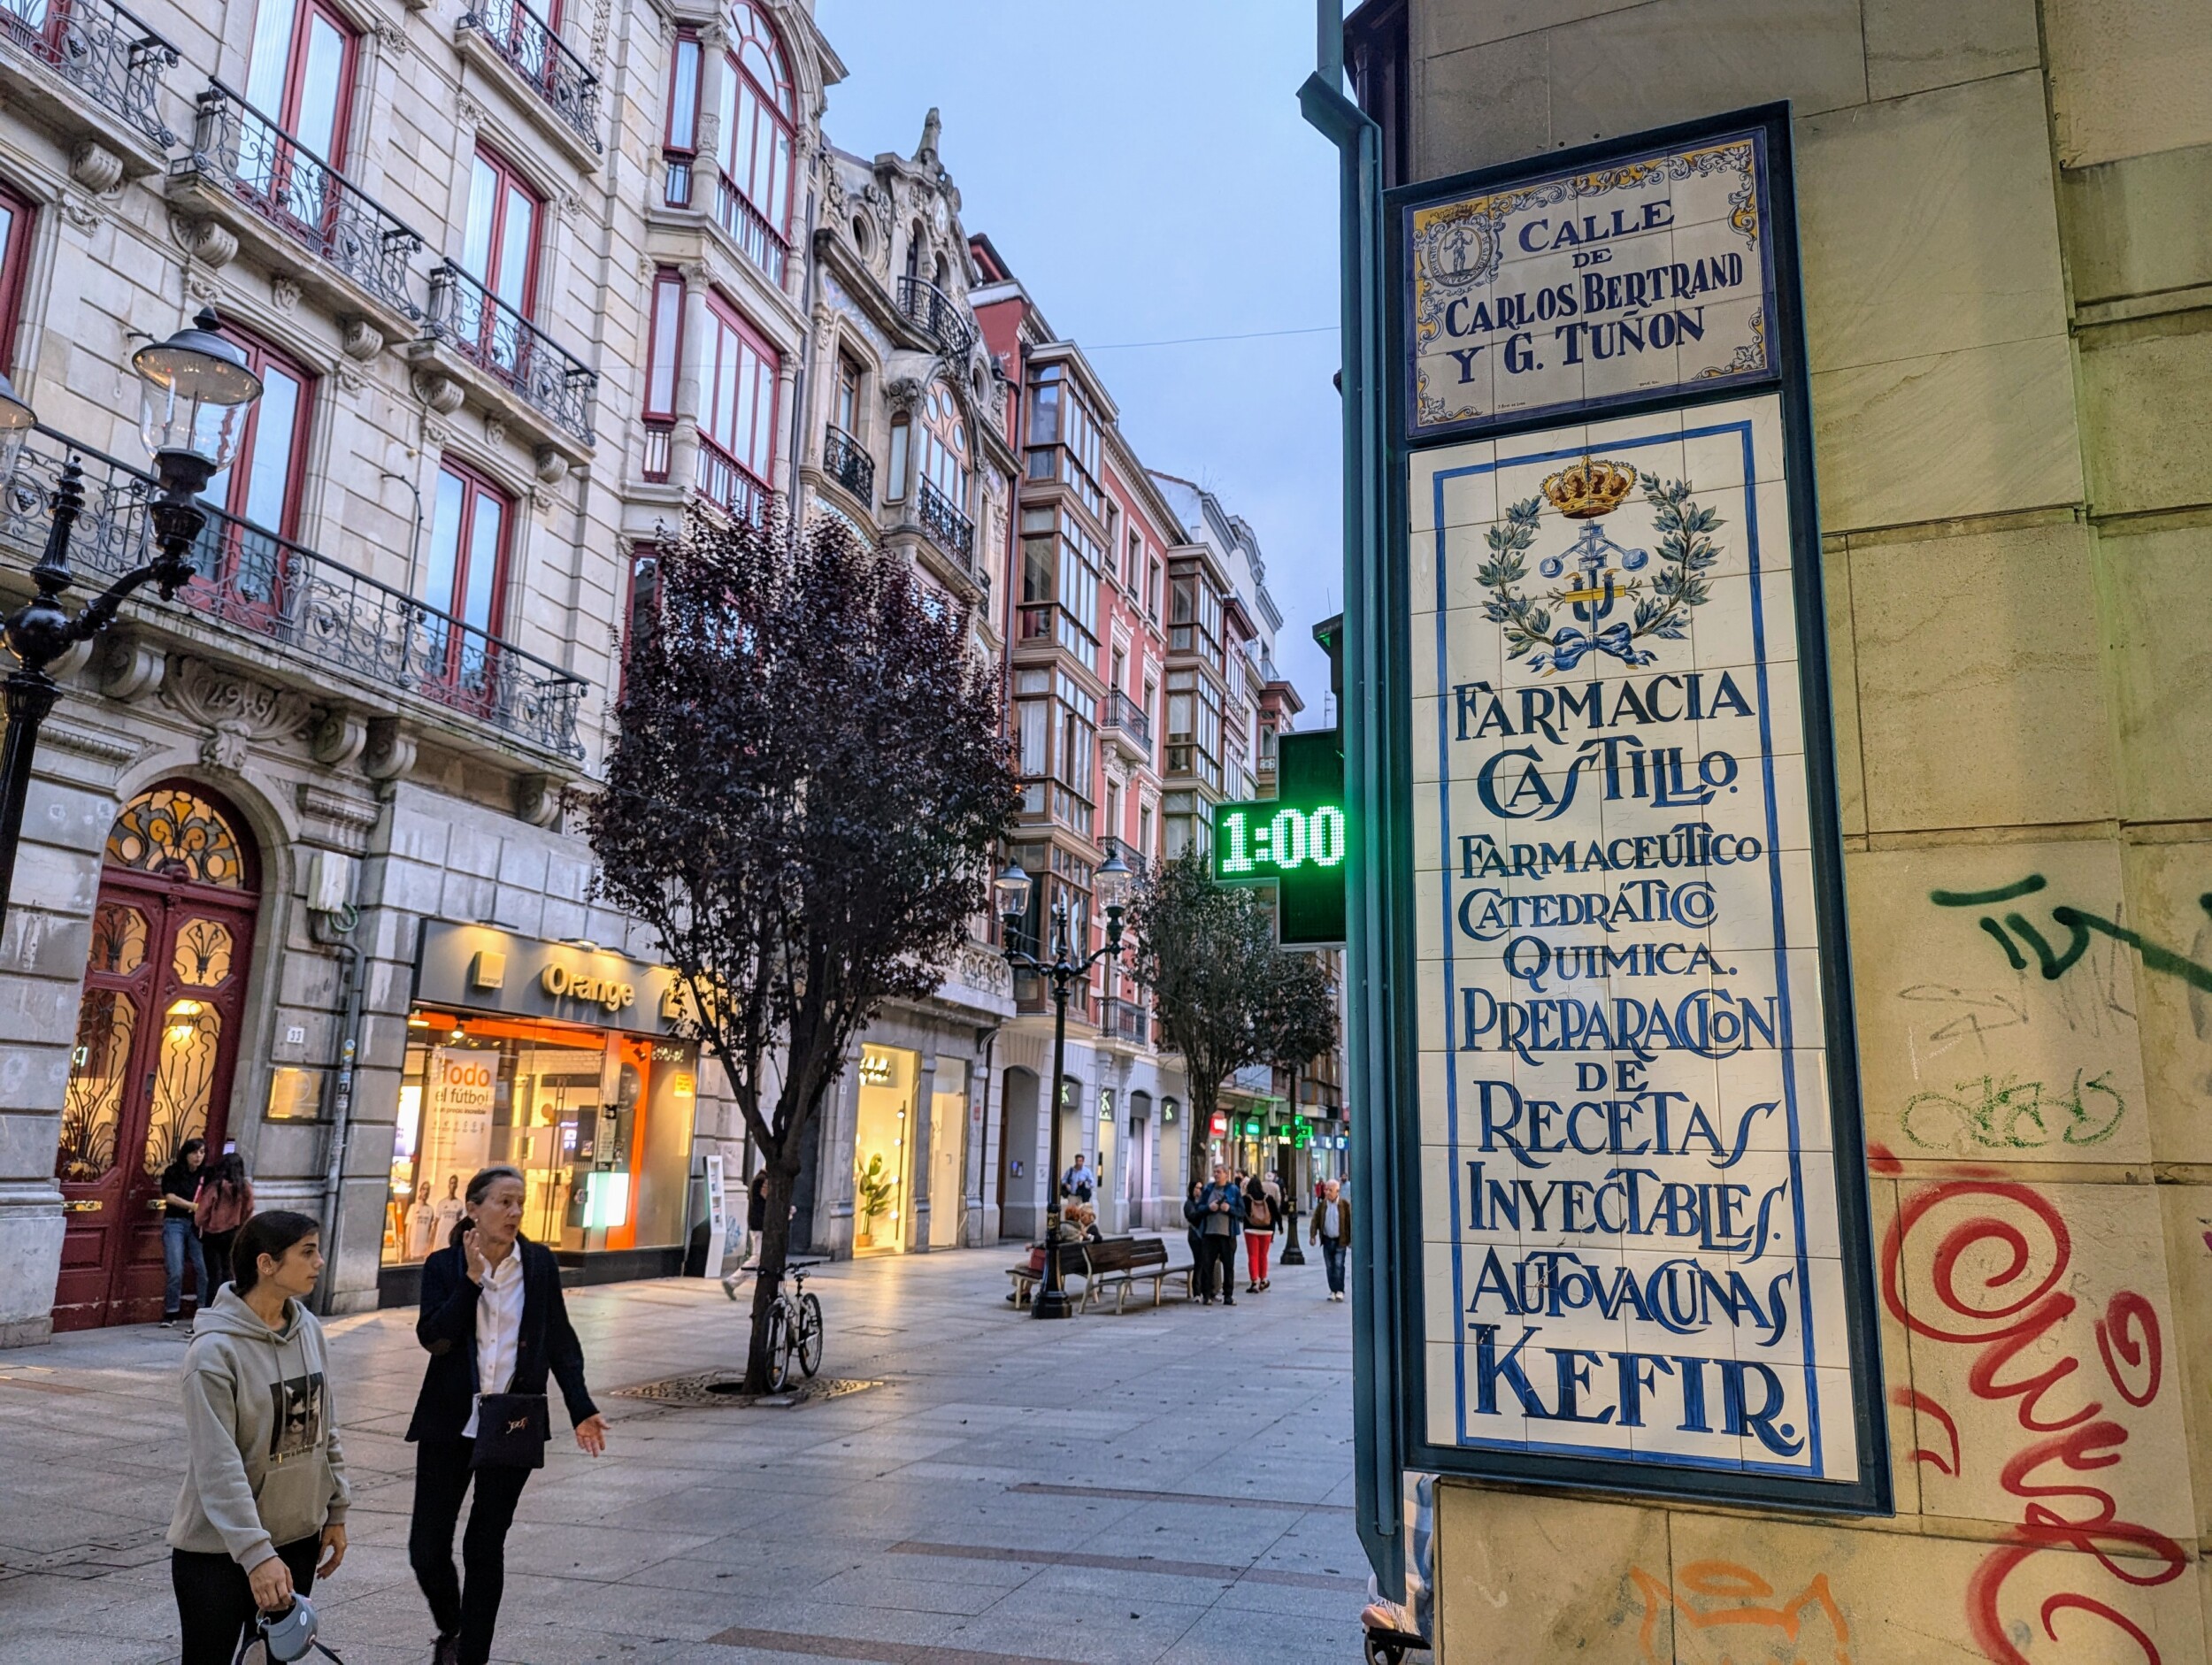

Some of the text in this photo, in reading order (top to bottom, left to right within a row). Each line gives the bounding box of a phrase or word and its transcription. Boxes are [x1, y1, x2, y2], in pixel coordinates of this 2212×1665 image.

[1518, 199, 1675, 252] CALLE
[1572, 248, 1613, 269] DE
[1445, 252, 1743, 338] CARLOS BERTRAND
[1446, 347, 1485, 384] Y
[1504, 332, 1544, 375] G.
[1452, 670, 1755, 745] FARMACIA
[1222, 805, 1345, 872] 1:00
[542, 962, 635, 1012] Orange
[1460, 987, 1778, 1067] PREPARACION
[435, 1087, 489, 1105] el fútbol
[440, 1059, 491, 1087] Todo
[1575, 1061, 1649, 1092] DE
[1473, 1079, 1782, 1170] RECETAS
[1465, 1245, 1794, 1347] AUTOVACUNAS
[1467, 1322, 1805, 1457] KEFIR.
